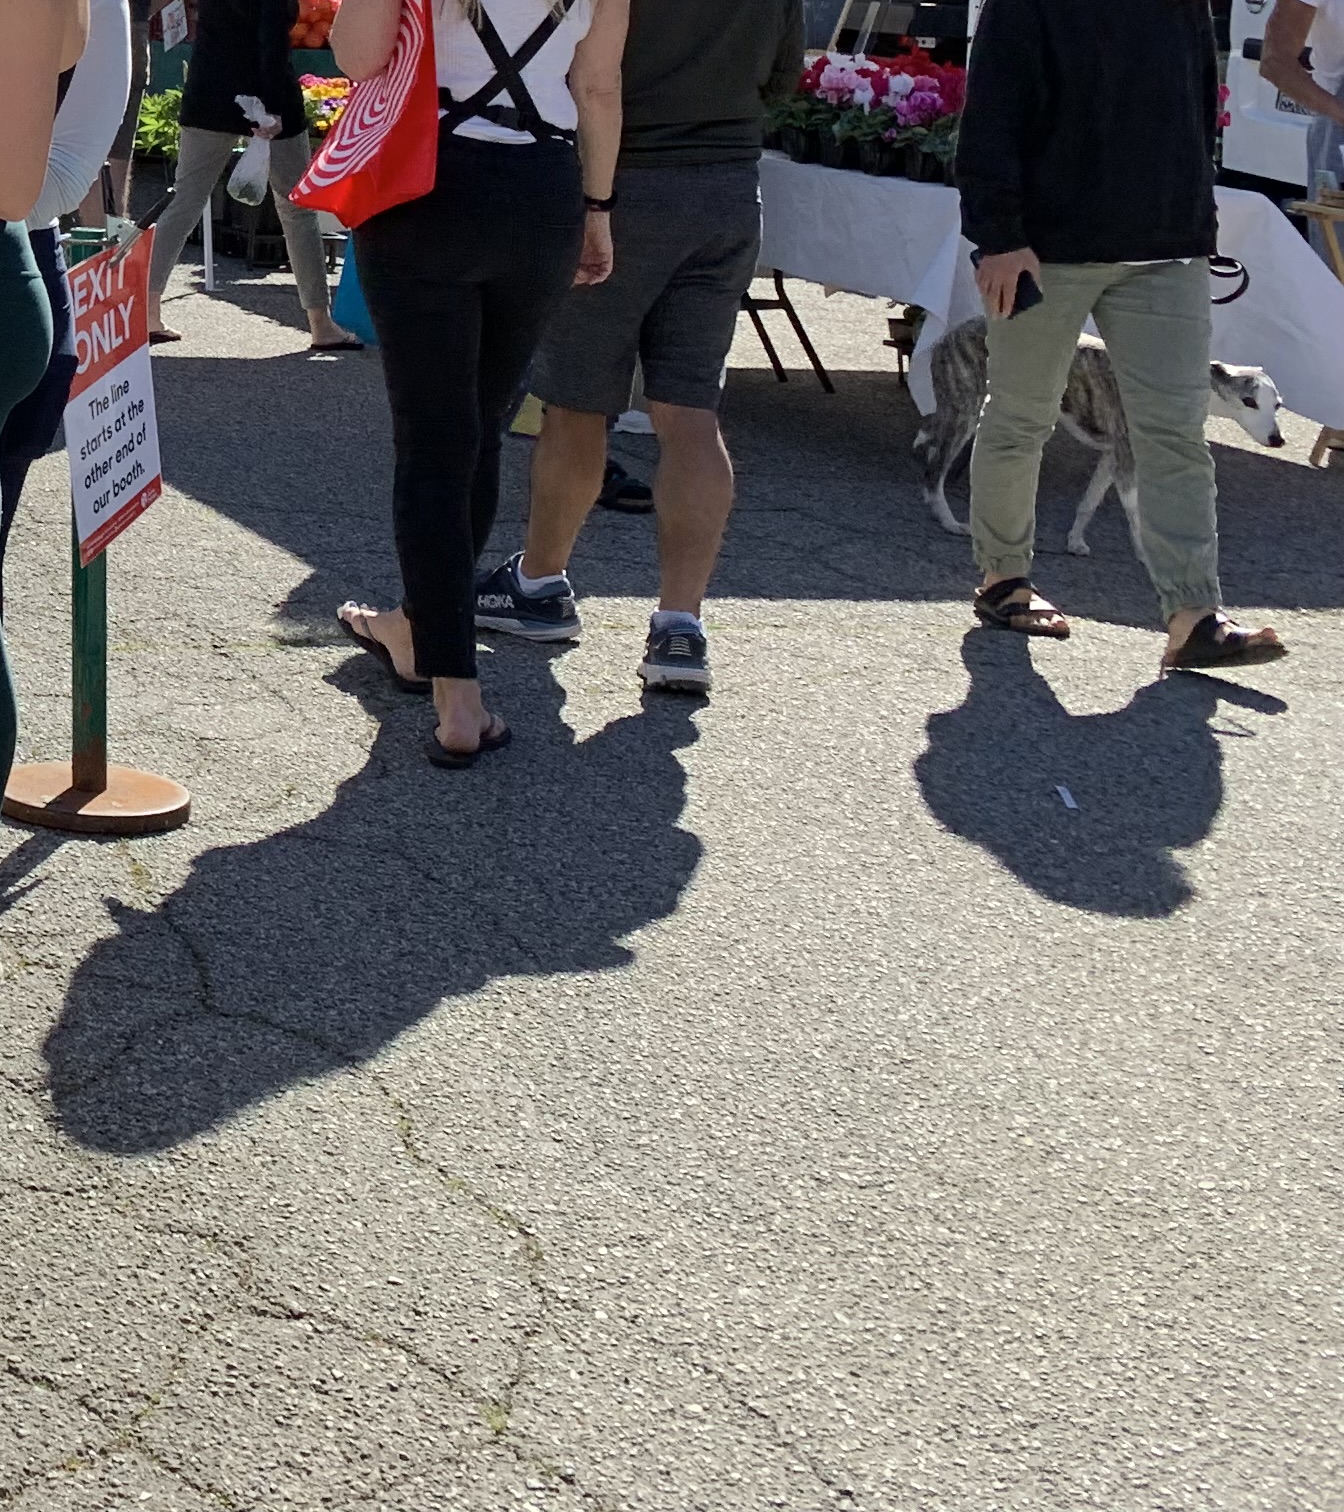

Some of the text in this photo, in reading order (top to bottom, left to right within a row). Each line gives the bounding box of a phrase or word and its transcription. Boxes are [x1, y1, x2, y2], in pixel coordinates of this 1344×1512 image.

[73, 249, 132, 319] EXIT
[75, 294, 135, 375] ONLY
[80, 398, 145, 461] starts at the
[88, 379, 130, 420] The line
[84, 421, 147, 489] other end of
[93, 459, 146, 514] our booth.
[477, 594, 515, 609] HOKA
